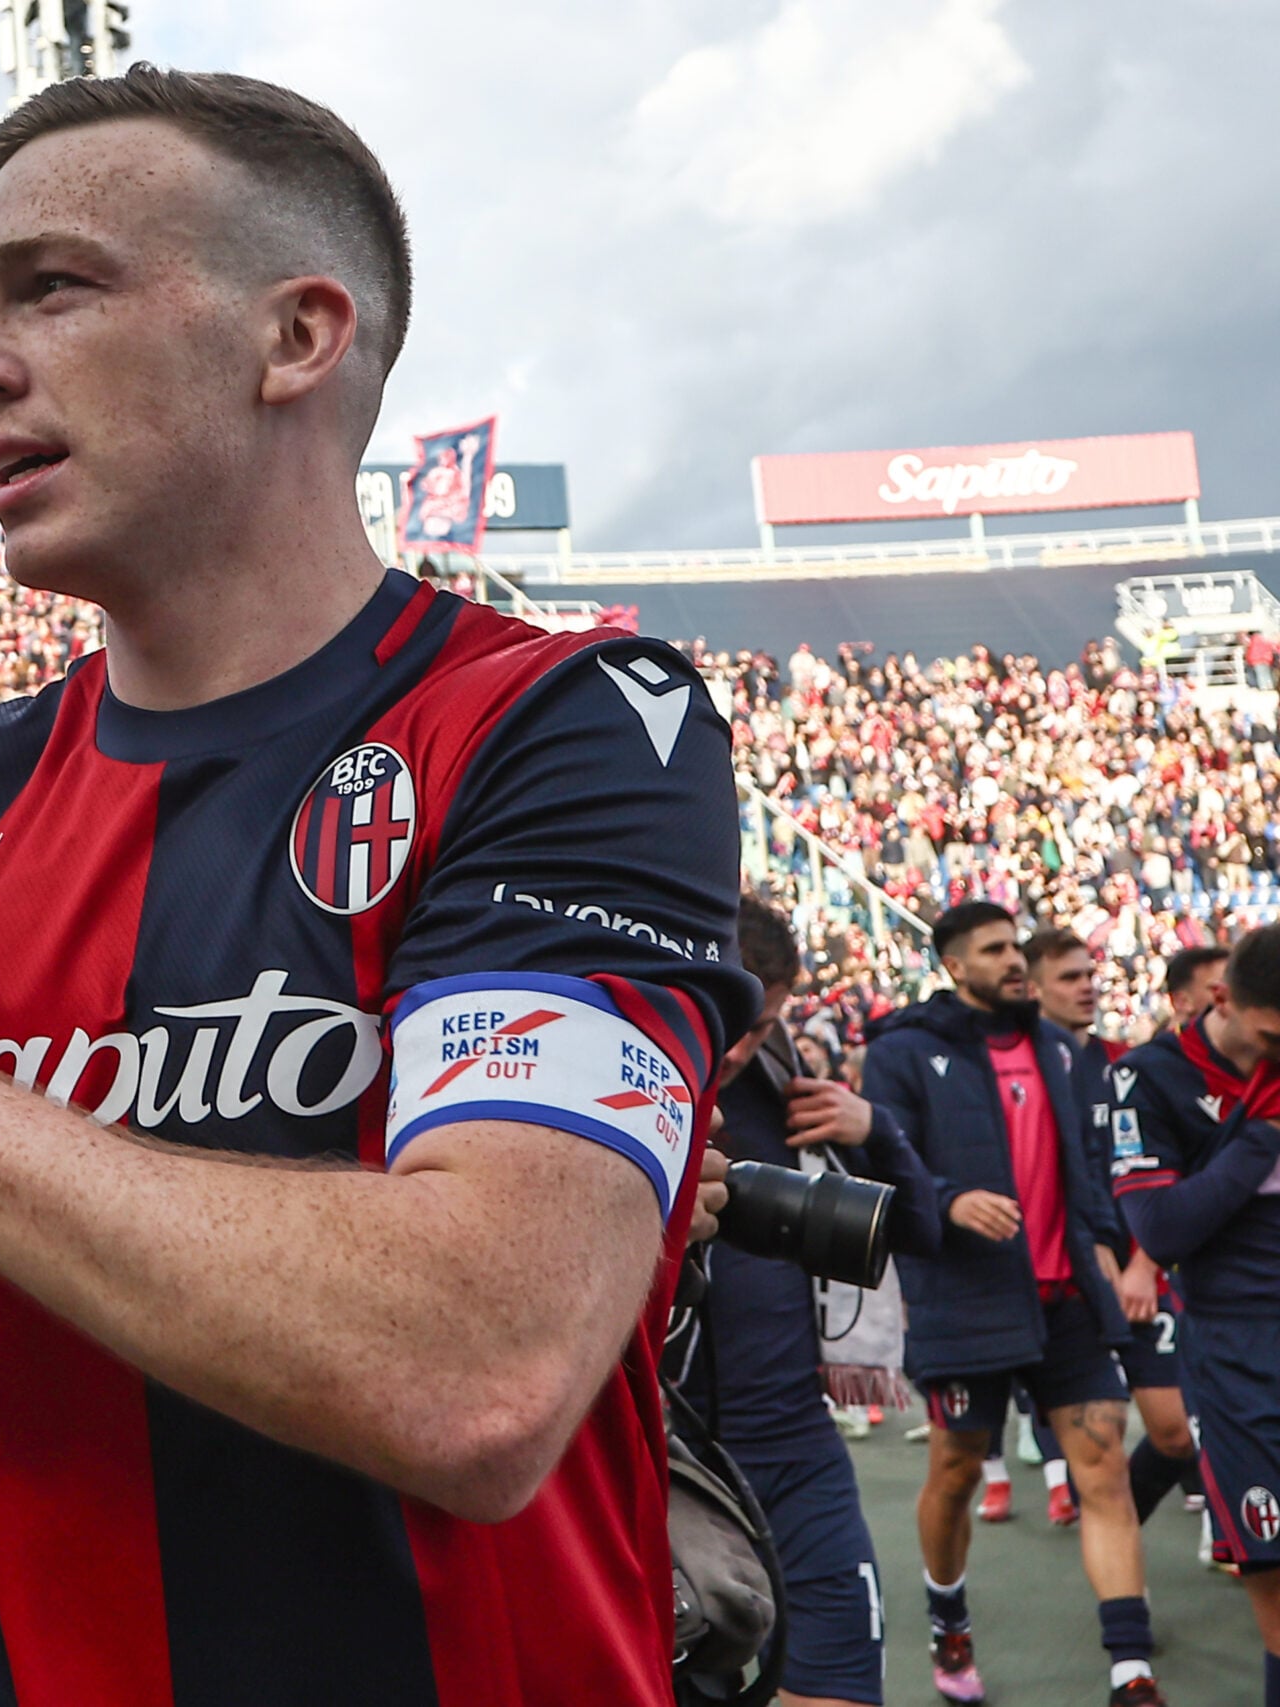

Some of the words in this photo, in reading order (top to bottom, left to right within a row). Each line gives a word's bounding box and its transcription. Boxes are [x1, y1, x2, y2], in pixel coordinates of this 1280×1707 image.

[878, 449, 1078, 514] Saputo
[330, 749, 387, 787] BFC
[337, 778, 375, 794] 1909
[442, 1011, 505, 1036] KEEP
[442, 1036, 539, 1062] RACISM
[621, 1040, 670, 1082] KEEP
[486, 1061, 537, 1080] OUT
[621, 1063, 683, 1132] RACISM
[656, 1113, 679, 1152] OUT
